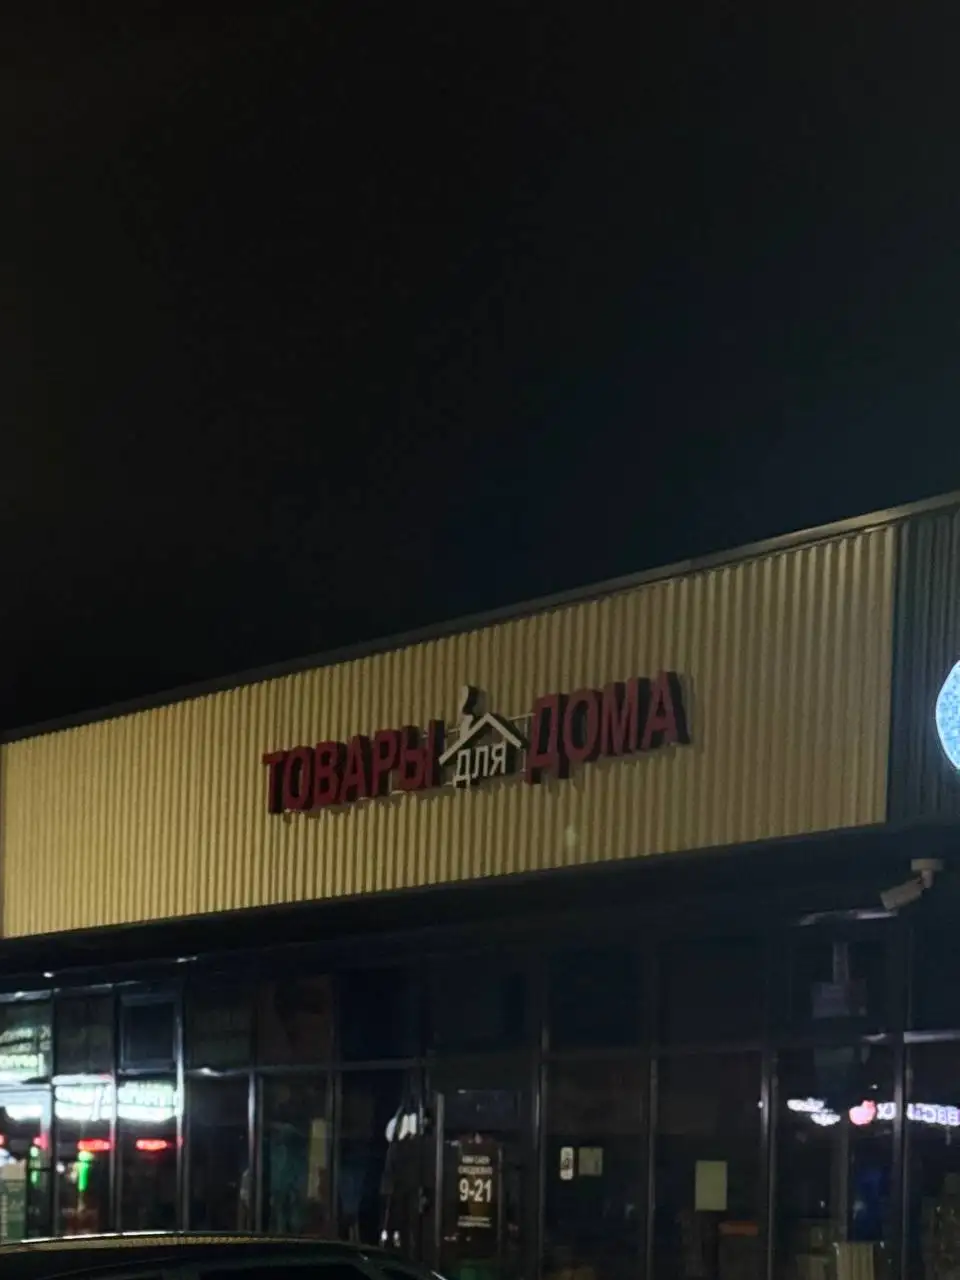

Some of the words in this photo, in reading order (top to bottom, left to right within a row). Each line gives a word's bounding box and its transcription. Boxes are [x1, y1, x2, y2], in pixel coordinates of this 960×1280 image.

[262, 719, 444, 814] ТОВАРЫ
[453, 743, 507, 787] ДЛЯ
[526, 671, 689, 783] ДОМА
[459, 1178, 492, 1202] 9-21
